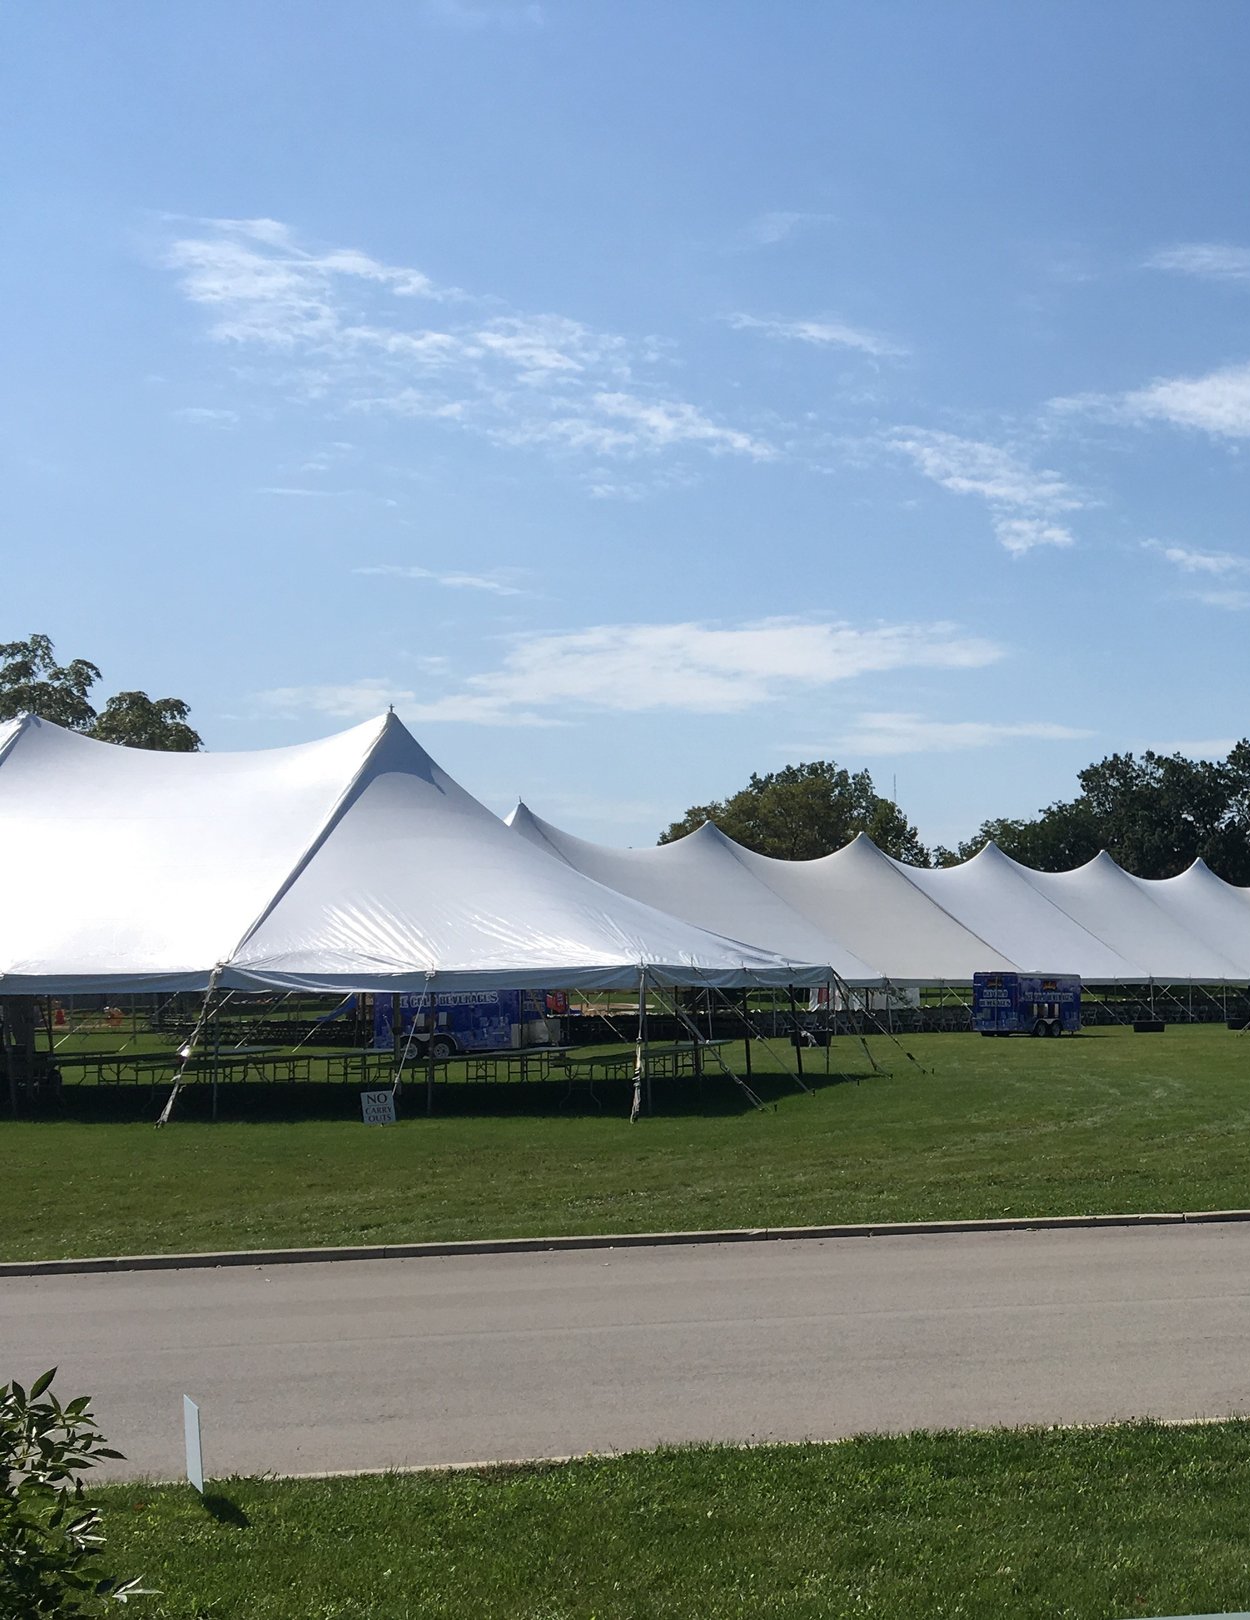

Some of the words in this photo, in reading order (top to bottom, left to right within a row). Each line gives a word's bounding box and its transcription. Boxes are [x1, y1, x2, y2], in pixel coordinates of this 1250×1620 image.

[439, 991, 499, 1007] BEVERAGES
[367, 1093, 387, 1104] NO
[366, 1106, 392, 1114] CARRY
[368, 1113, 392, 1123] OUTS
